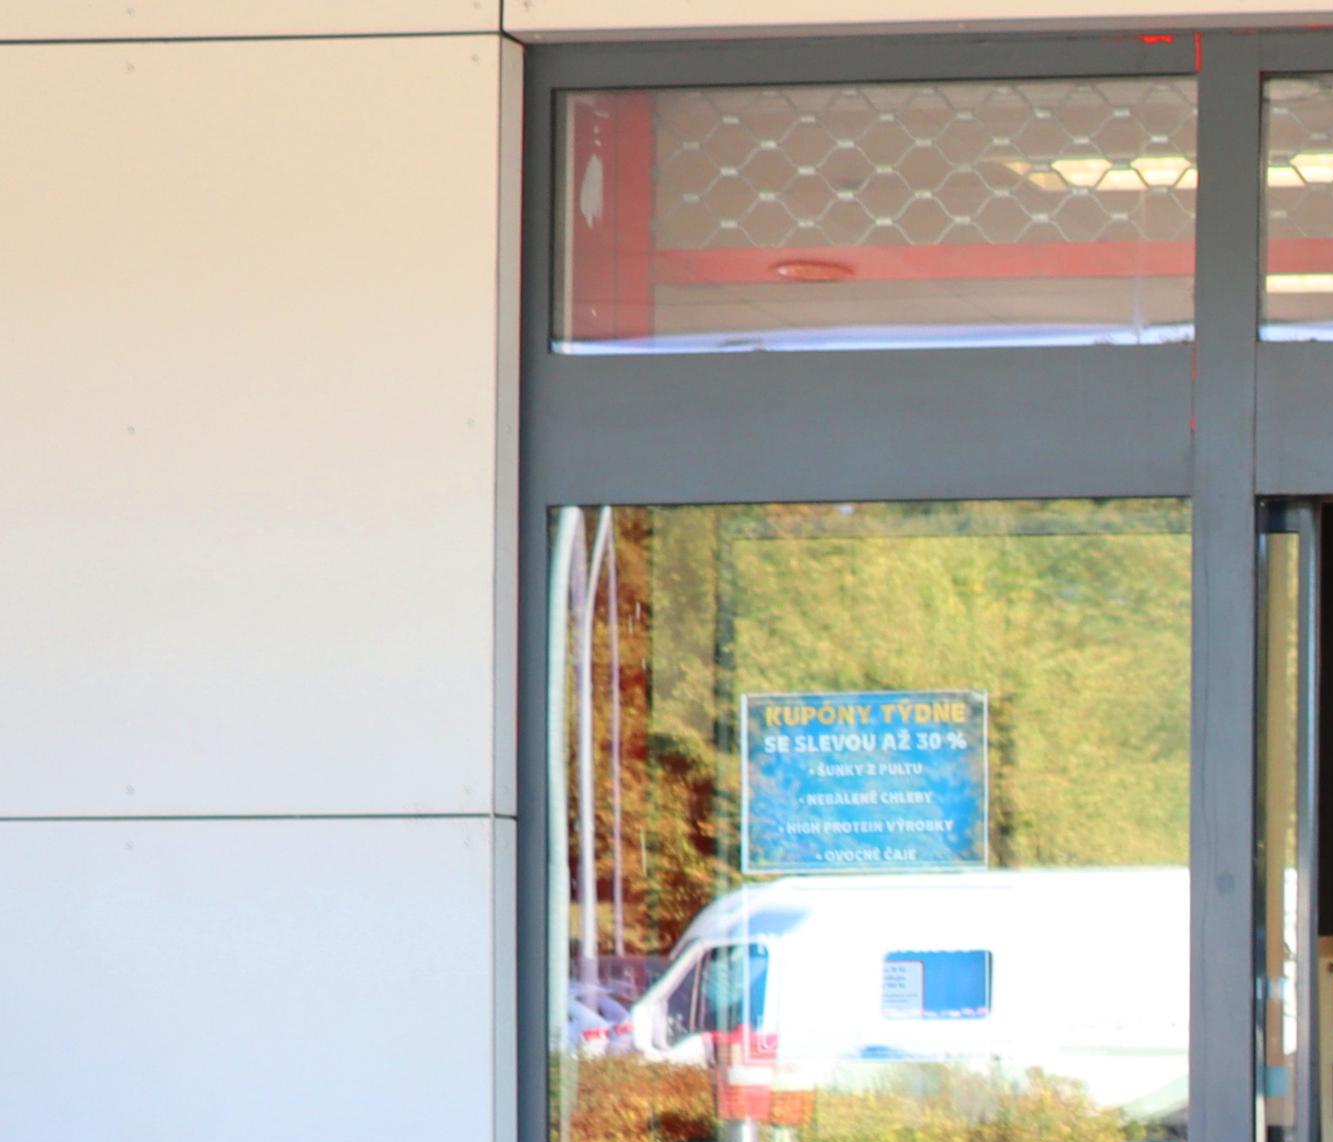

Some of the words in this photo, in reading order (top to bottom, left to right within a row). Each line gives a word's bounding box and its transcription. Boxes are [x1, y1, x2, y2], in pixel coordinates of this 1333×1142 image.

[764, 700, 872, 726] KUPÓNY
[880, 699, 968, 724] TÝDNE
[764, 734, 790, 753] SE
[795, 732, 876, 752] SLEVOU
[881, 728, 911, 750] AŽ
[916, 732, 944, 750] 30
[946, 732, 967, 750] %
[817, 762, 863, 777] ŠUNKY
[878, 762, 923, 775] PULTU
[787, 821, 823, 835] HIGH
[824, 820, 884, 834] PROTEIN
[886, 819, 954, 833] VÝROBKY
[823, 848, 881, 862] OVOCNÉ
[883, 847, 917, 861] ČAJE
